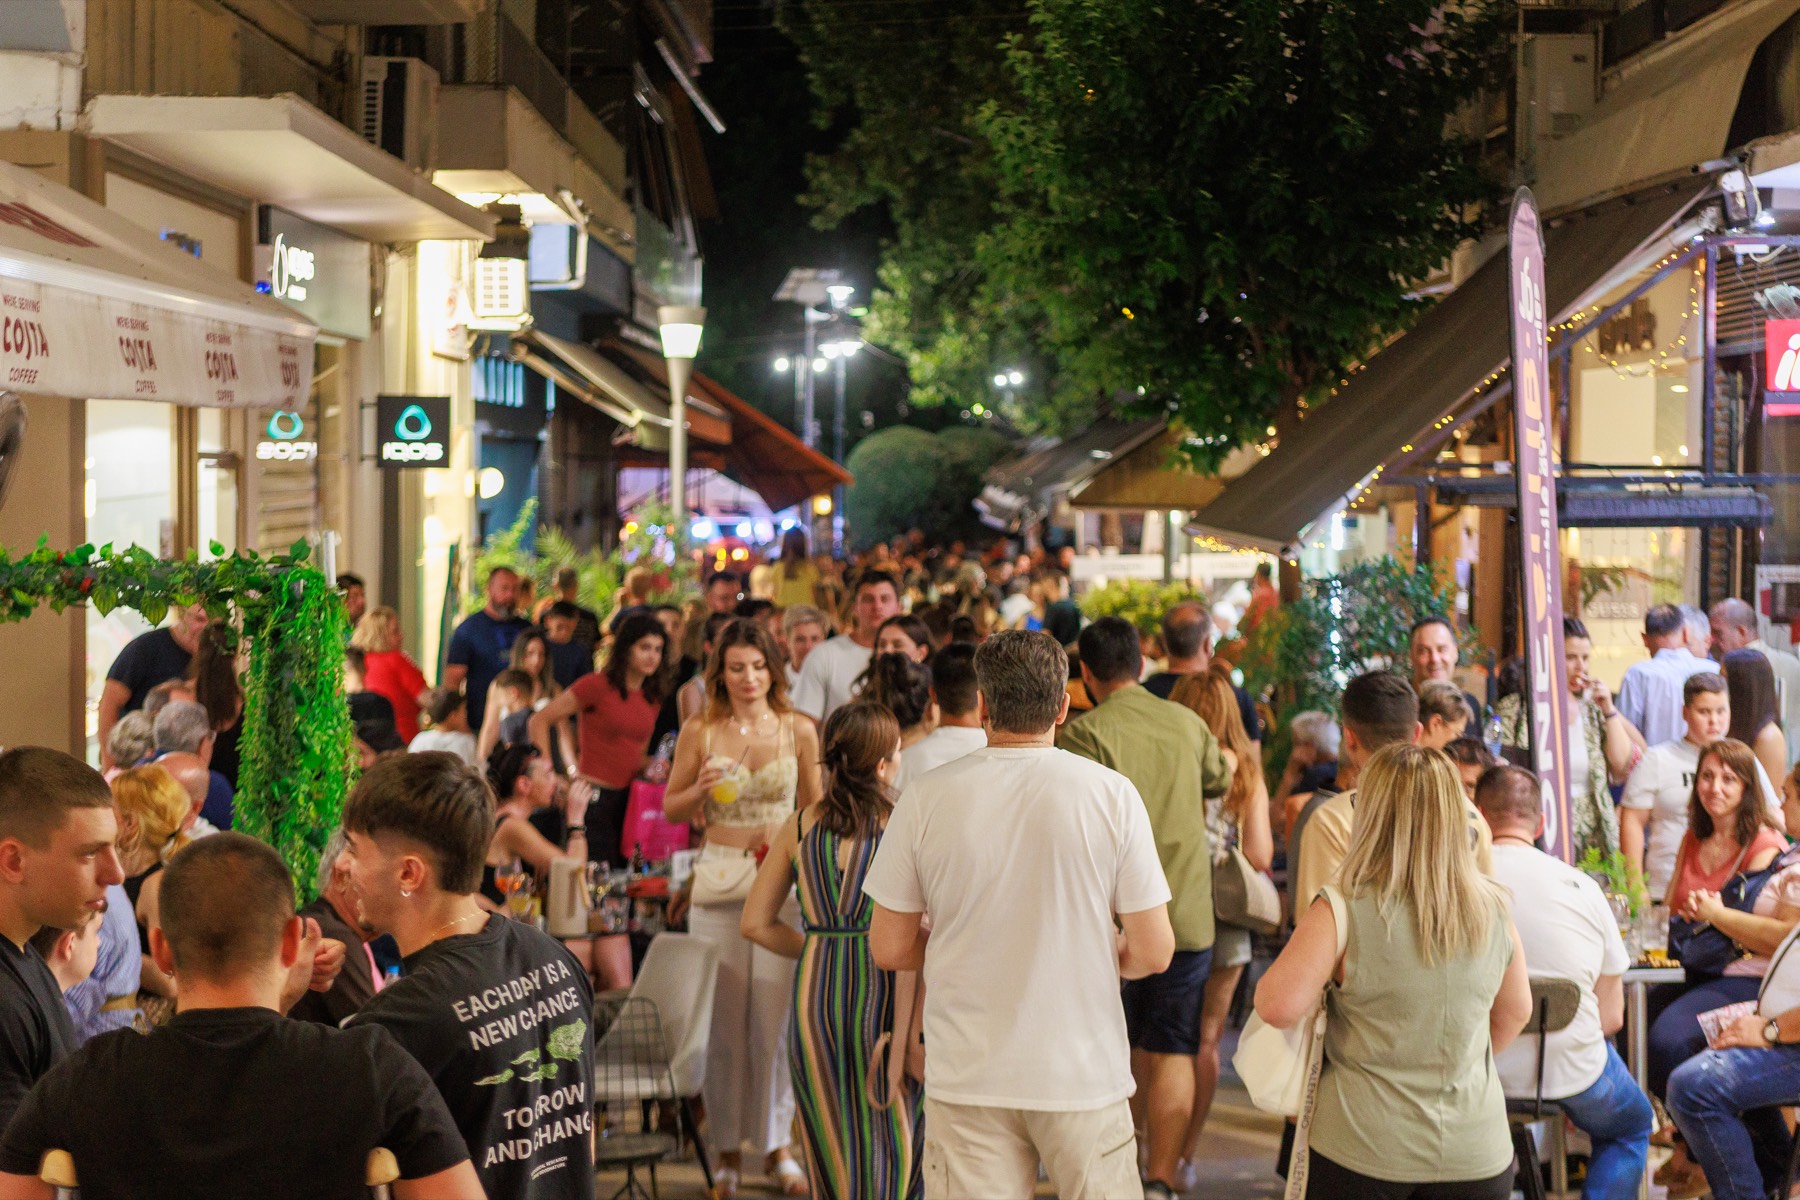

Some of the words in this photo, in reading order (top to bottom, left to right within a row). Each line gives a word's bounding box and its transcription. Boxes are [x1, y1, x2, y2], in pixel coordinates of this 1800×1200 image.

[3, 316, 49, 361] COSTA
[119, 336, 157, 372] COSTA
[9, 367, 38, 384] COFFEE
[382, 442, 444, 462] IQOS
[452, 984, 514, 1022] EACH
[509, 969, 542, 1001] DAY
[542, 962, 560, 985] IS
[556, 959, 571, 979] A
[468, 1014, 518, 1051] NEW
[1301, 1061, 1319, 1129] VALENTINO
[503, 1106, 534, 1130] TO
[484, 1138, 533, 1169] AND
